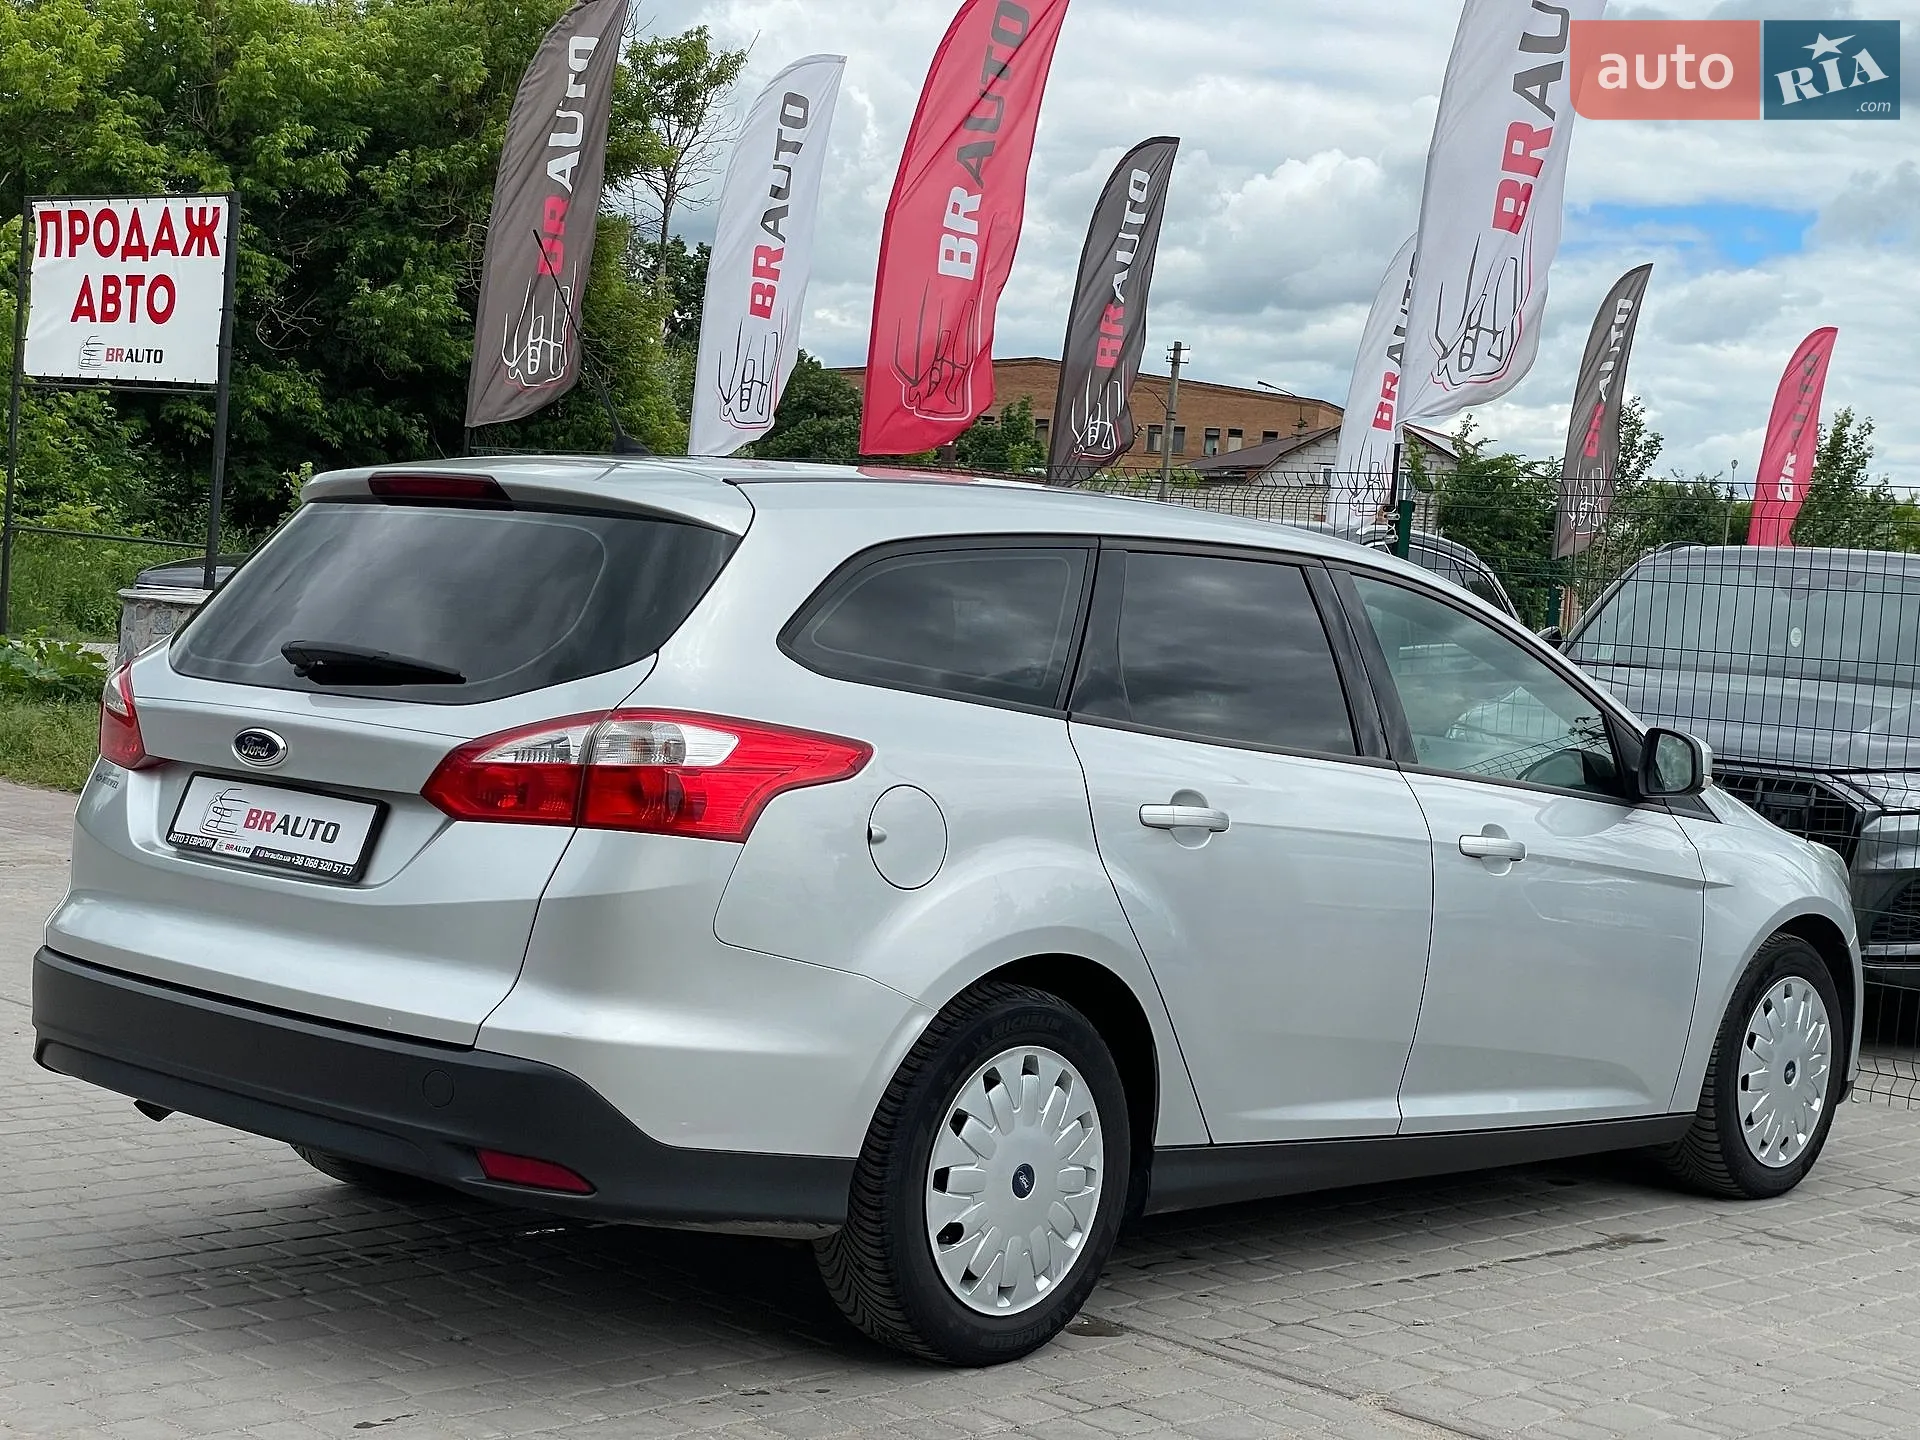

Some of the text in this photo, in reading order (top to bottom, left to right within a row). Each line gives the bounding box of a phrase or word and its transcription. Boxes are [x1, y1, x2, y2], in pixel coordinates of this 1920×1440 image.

[937, 0, 1030, 281] BRAUTO
[750, 91, 810, 320] BRAUTO
[38, 206, 221, 262] ПРОДАЖ
[1095, 168, 1150, 368] BRAUTO
[70, 274, 176, 325] АВТО
[105, 347, 164, 364] BRAUTO
[241, 735, 269, 758] Ford
[243, 808, 341, 844] BRAUTO
[225, 843, 251, 854] BRAUTO
[292, 855, 304, 866] +38
[304, 858, 319, 869] 068
[319, 860, 333, 872] 320
[333, 864, 343, 874] 57
[342, 866, 353, 876] 57
